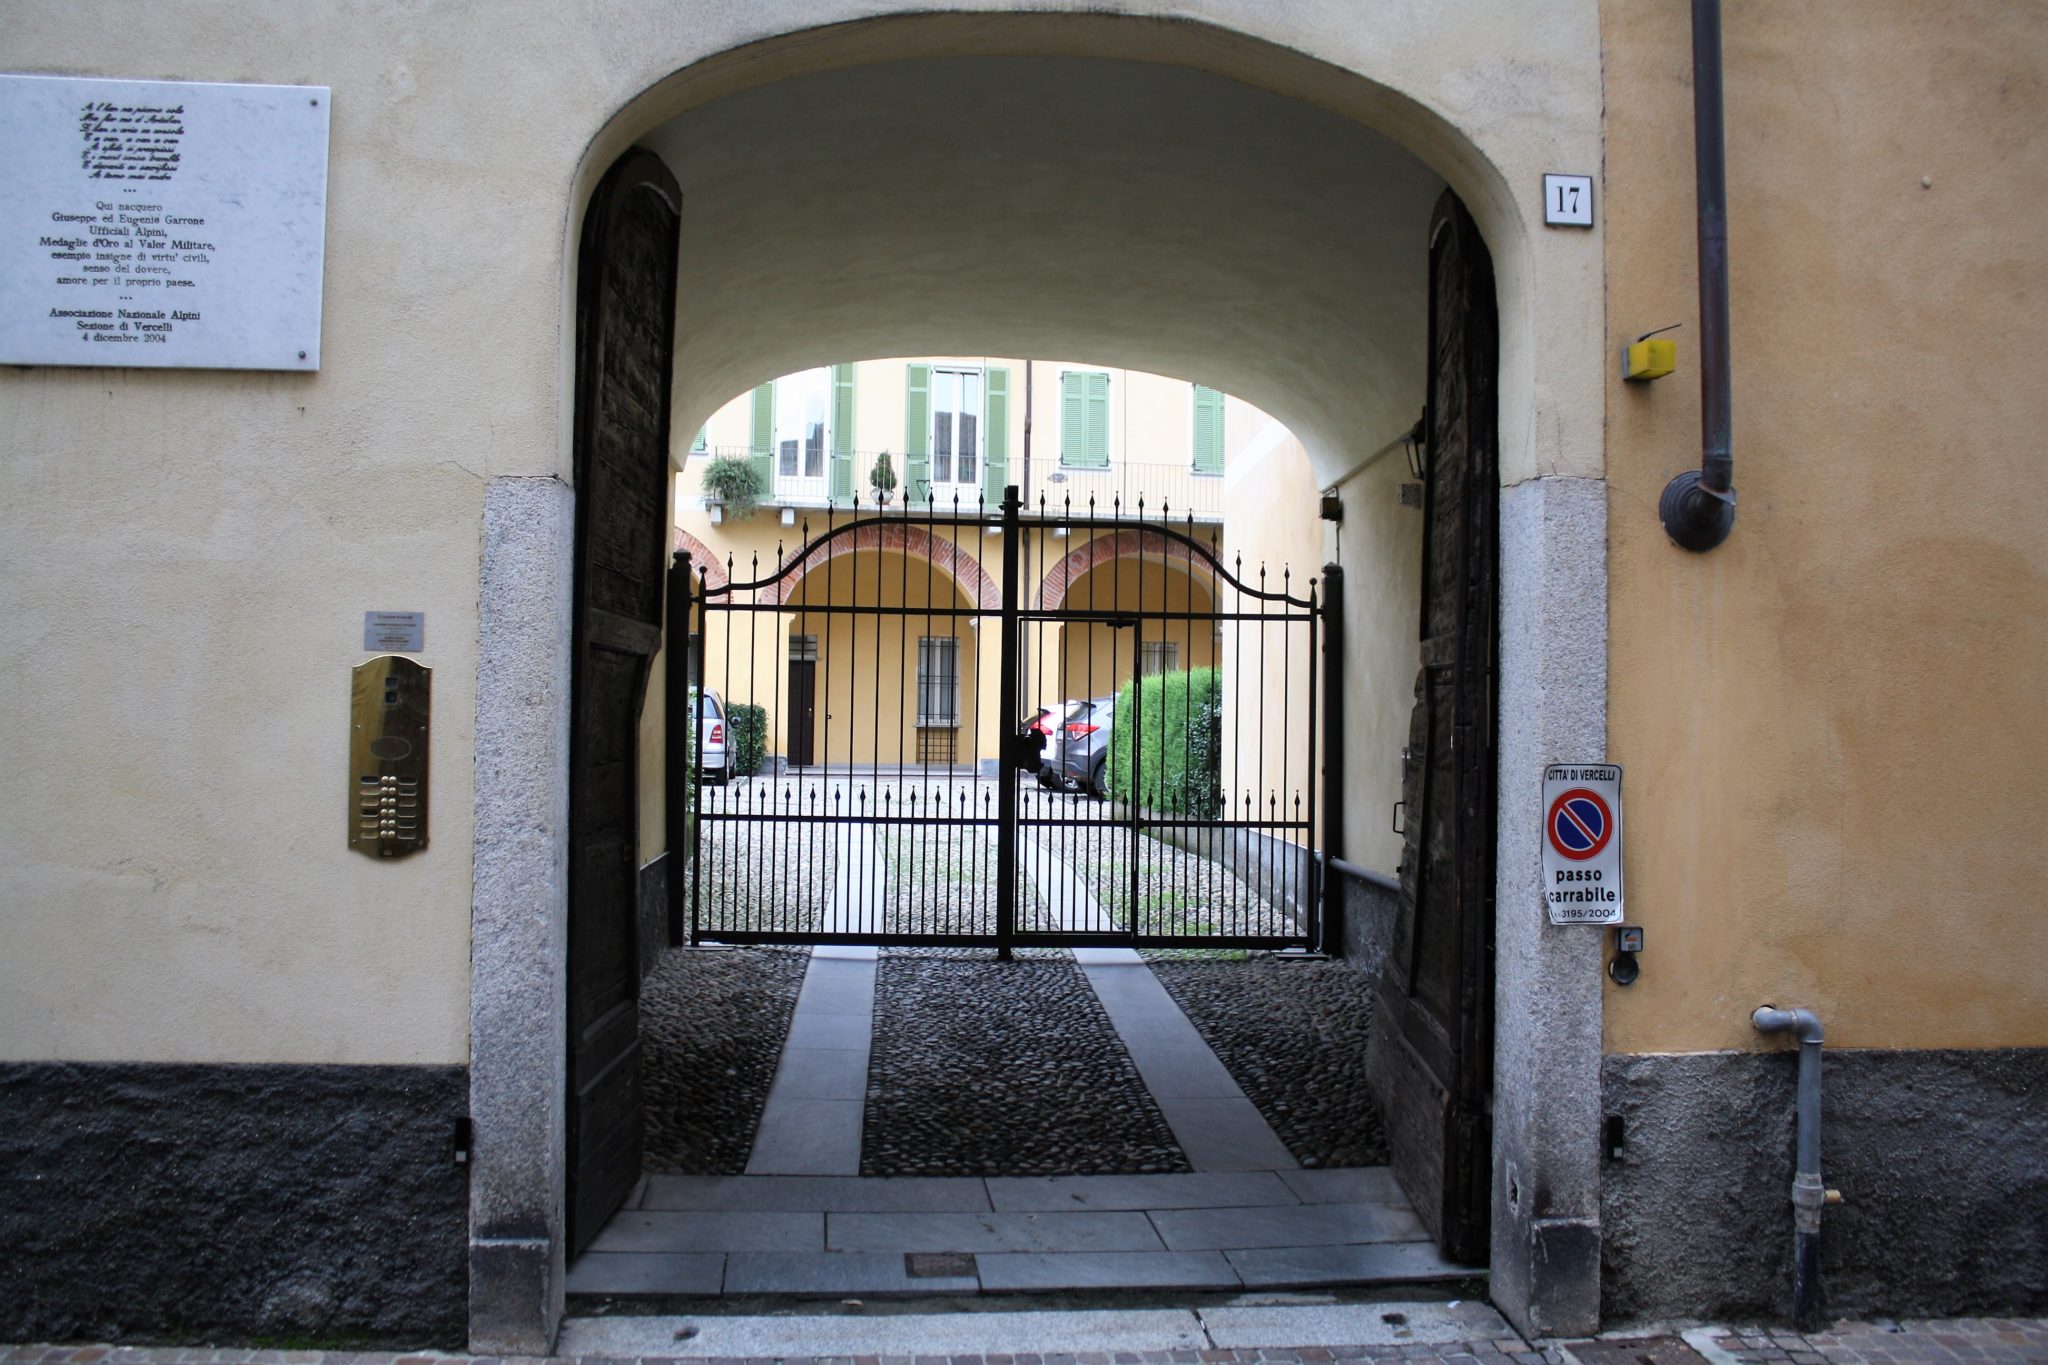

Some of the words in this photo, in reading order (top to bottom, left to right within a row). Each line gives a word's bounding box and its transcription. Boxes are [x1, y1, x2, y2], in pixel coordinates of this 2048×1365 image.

[1556, 186, 1580, 214] 17
[96, 201, 113, 210] Qui
[119, 203, 162, 212] nacquero
[52, 212, 97, 223] Giuseppe
[102, 213, 113, 222] ed
[119, 214, 160, 227] Eugenio
[165, 216, 204, 225] Garrone
[89, 225, 130, 236] Ufficiali
[135, 227, 168, 238] Alpini,
[39, 237, 88, 250] Medaglie
[93, 238, 119, 248] d'Oro
[124, 240, 133, 248] al
[139, 240, 165, 249] Valor
[172, 241, 215, 251] Militare,
[51, 252, 91, 261] esempio
[96, 252, 132, 264] insigne
[137, 252, 146, 261] di
[152, 253, 178, 262] virtu'
[183, 254, 209, 264] civili,
[83, 265, 110, 273] senso
[115, 264, 130, 273] del
[135, 265, 171, 274] dovere,
[56, 277, 87, 285] amore
[93, 278, 108, 286] per
[114, 277, 121, 285] il
[126, 277, 161, 288] proprio
[166, 279, 195, 288] paese.
[50, 308, 113, 318] Associazione
[118, 309, 166, 319] Nazionale
[171, 310, 201, 321] Alpini
[77, 321, 114, 331] Sezione
[120, 321, 128, 331] di
[134, 321, 172, 332] Vercelli
[82, 332, 88, 342] 4
[94, 333, 139, 342] dicembre
[144, 334, 166, 343] 2004
[1548, 769, 1569, 781] CITTA'
[1571, 769, 1578, 781] DI
[1580, 770, 1615, 781] VERCELLI
[1556, 869, 1602, 884] passo
[1549, 887, 1616, 903] carrabile
[1562, 909, 1616, 918] 3195/2004
